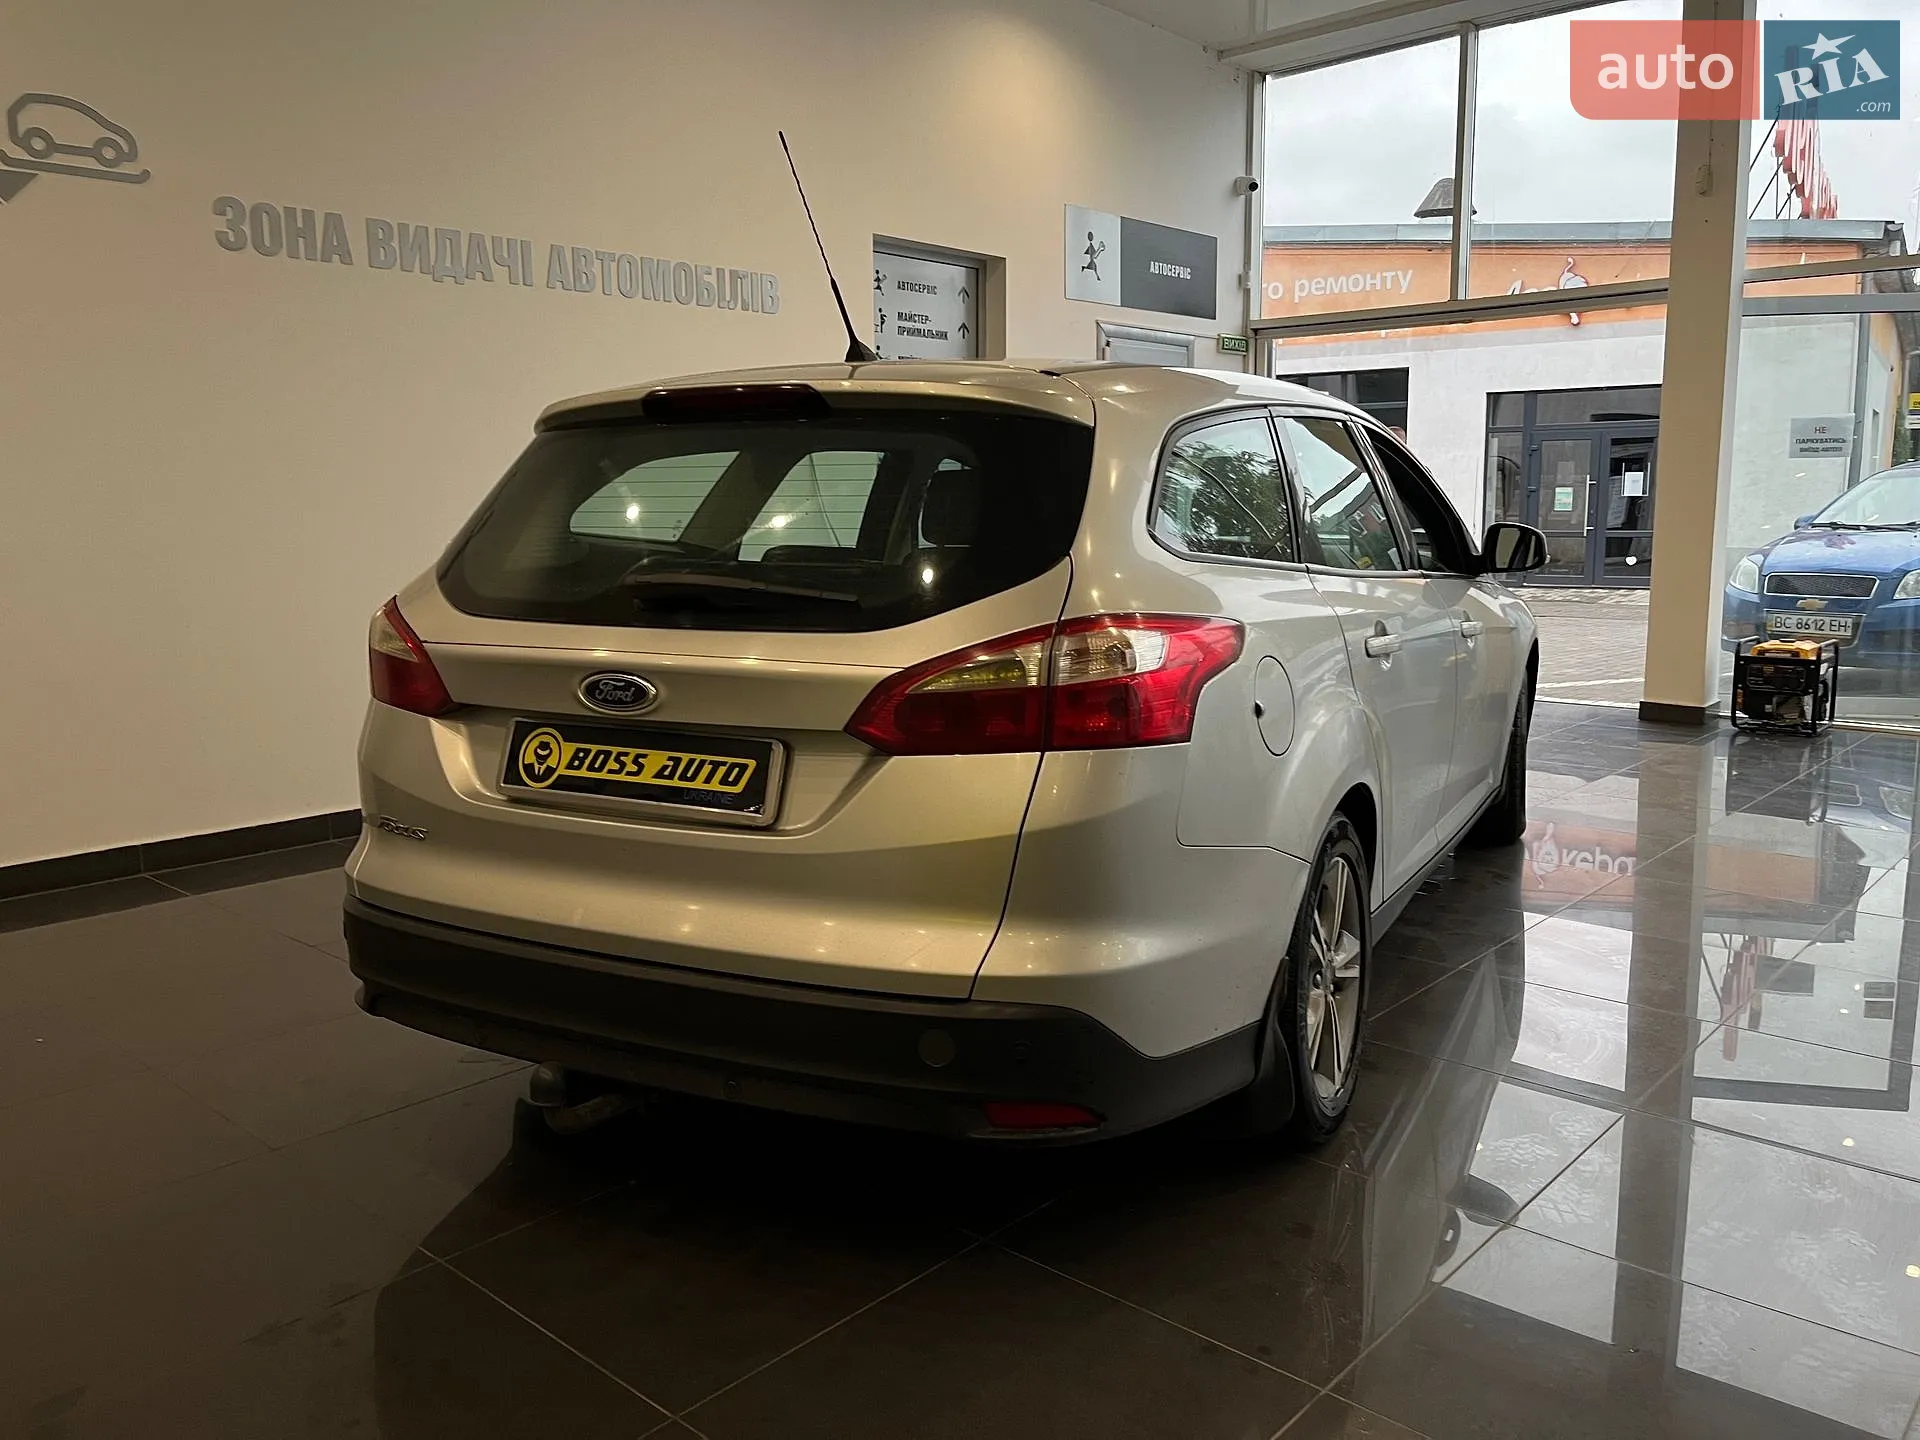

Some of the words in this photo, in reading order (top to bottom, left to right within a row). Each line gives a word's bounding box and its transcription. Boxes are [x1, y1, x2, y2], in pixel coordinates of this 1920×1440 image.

[212, 195, 353, 266] ЗОНА
[366, 217, 534, 287] ВИДАЧІ
[547, 244, 781, 315] АВТОМОБІЛІВ
[1149, 260, 1192, 280] АВТОСЕРВІС
[897, 280, 938, 295] АВТОСЕРВІС
[1294, 269, 1413, 303] ремонту
[897, 310, 932, 325] МАЙСТЕР-
[897, 325, 949, 341] ПРИЙМАЛЬНИК
[1814, 426, 1828, 434] НЕ
[1796, 617, 1825, 631] 8612
[595, 679, 636, 702] Ford
[566, 747, 648, 778] BOSS
[651, 755, 751, 787] AUTO
